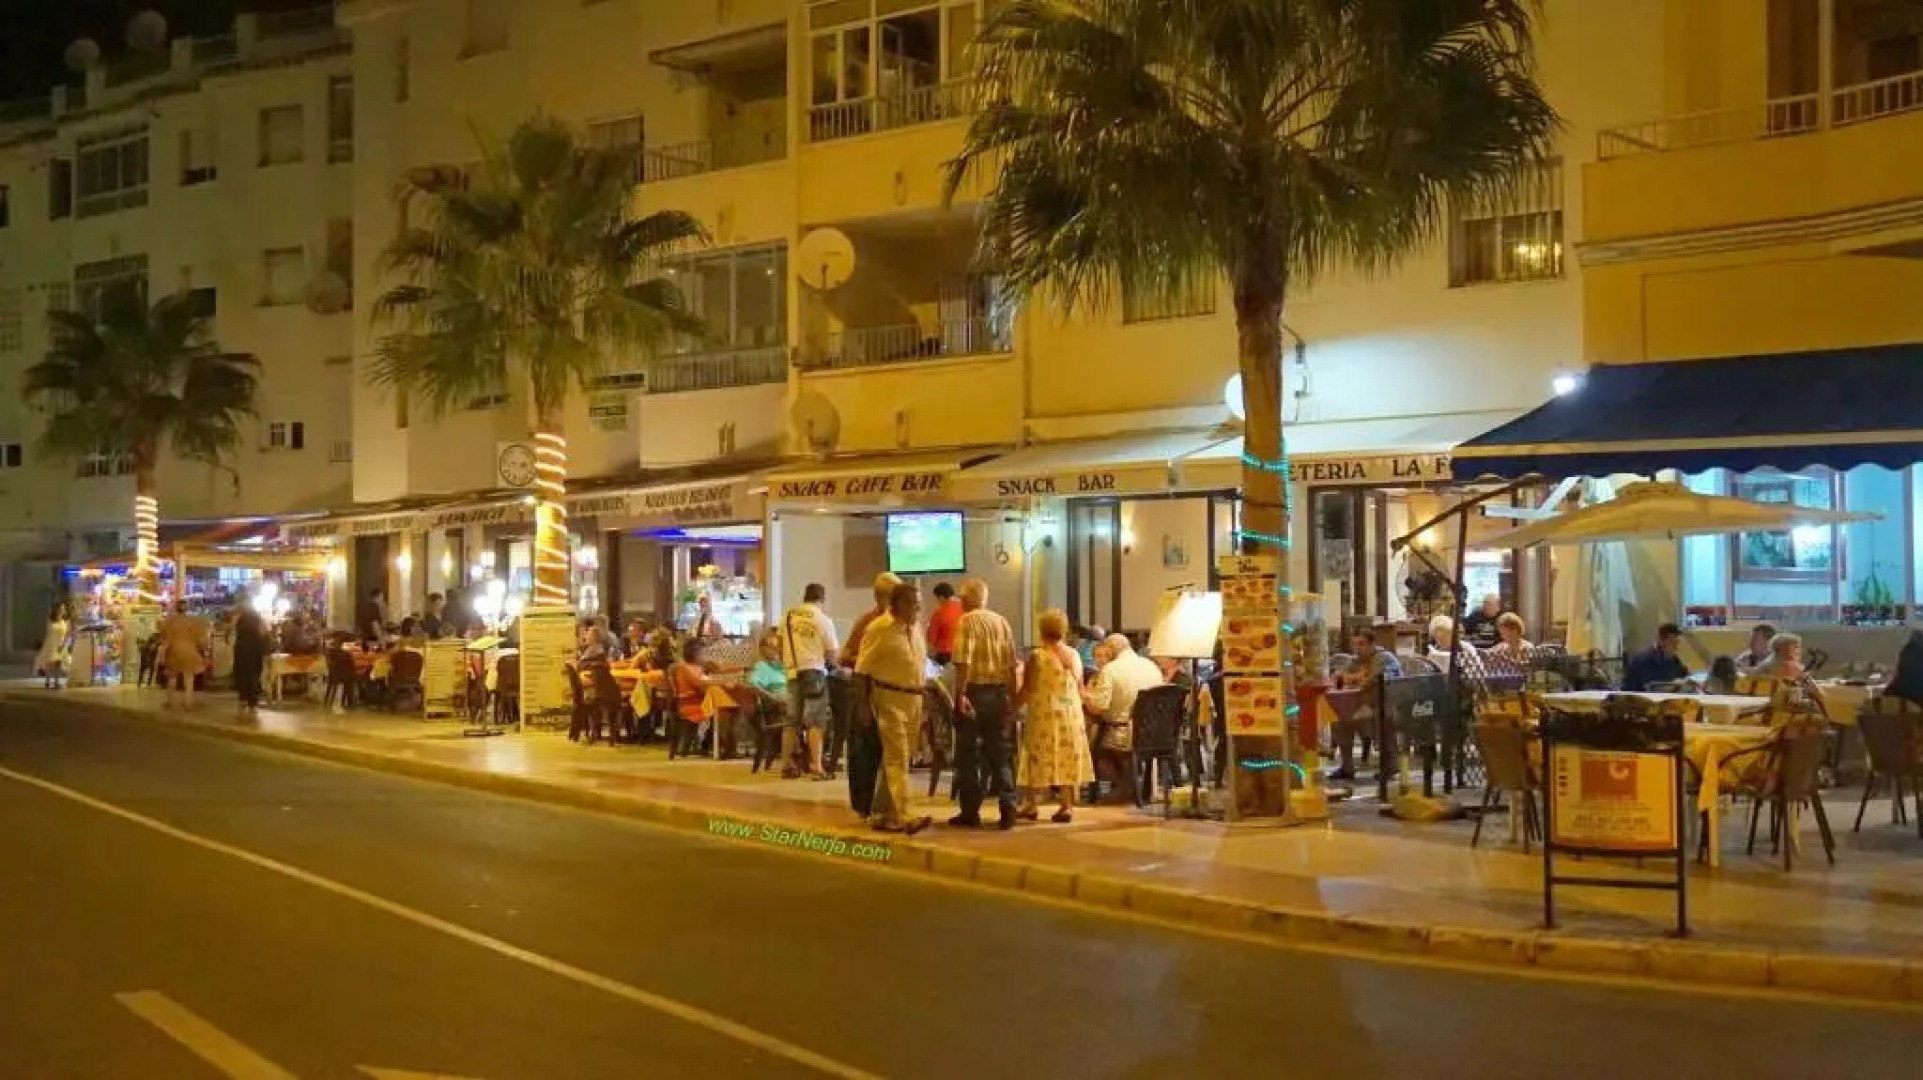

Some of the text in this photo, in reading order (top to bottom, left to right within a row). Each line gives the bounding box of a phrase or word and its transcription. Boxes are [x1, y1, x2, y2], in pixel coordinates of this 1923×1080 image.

[1392, 459, 1421, 476] LA
[779, 480, 837, 497] SNACK
[901, 473, 942, 491] BAR
[998, 474, 1115, 496] SNACK BAR
